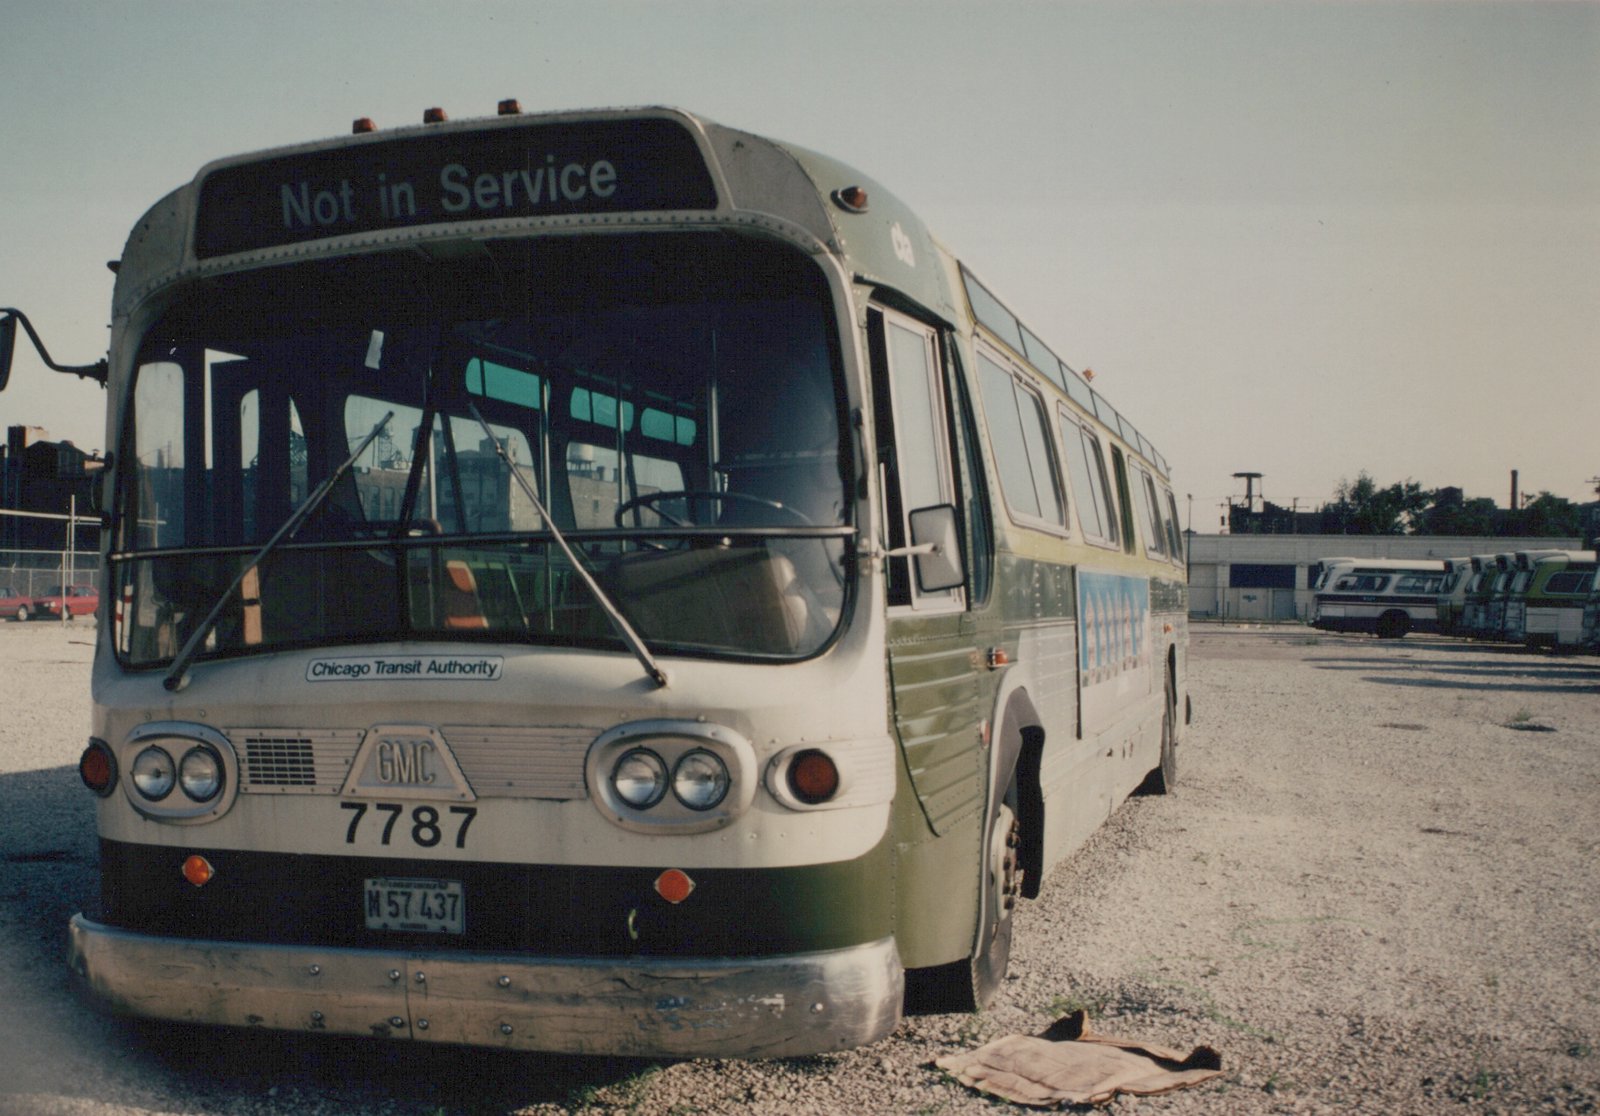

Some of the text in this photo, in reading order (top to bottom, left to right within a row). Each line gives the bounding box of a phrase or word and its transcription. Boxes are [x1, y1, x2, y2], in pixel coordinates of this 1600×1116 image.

[281, 154, 618, 229] Not in Service
[312, 659, 499, 678] Chicago Transit Authority
[375, 740, 436, 785] GMC
[340, 802, 478, 849] 7787
